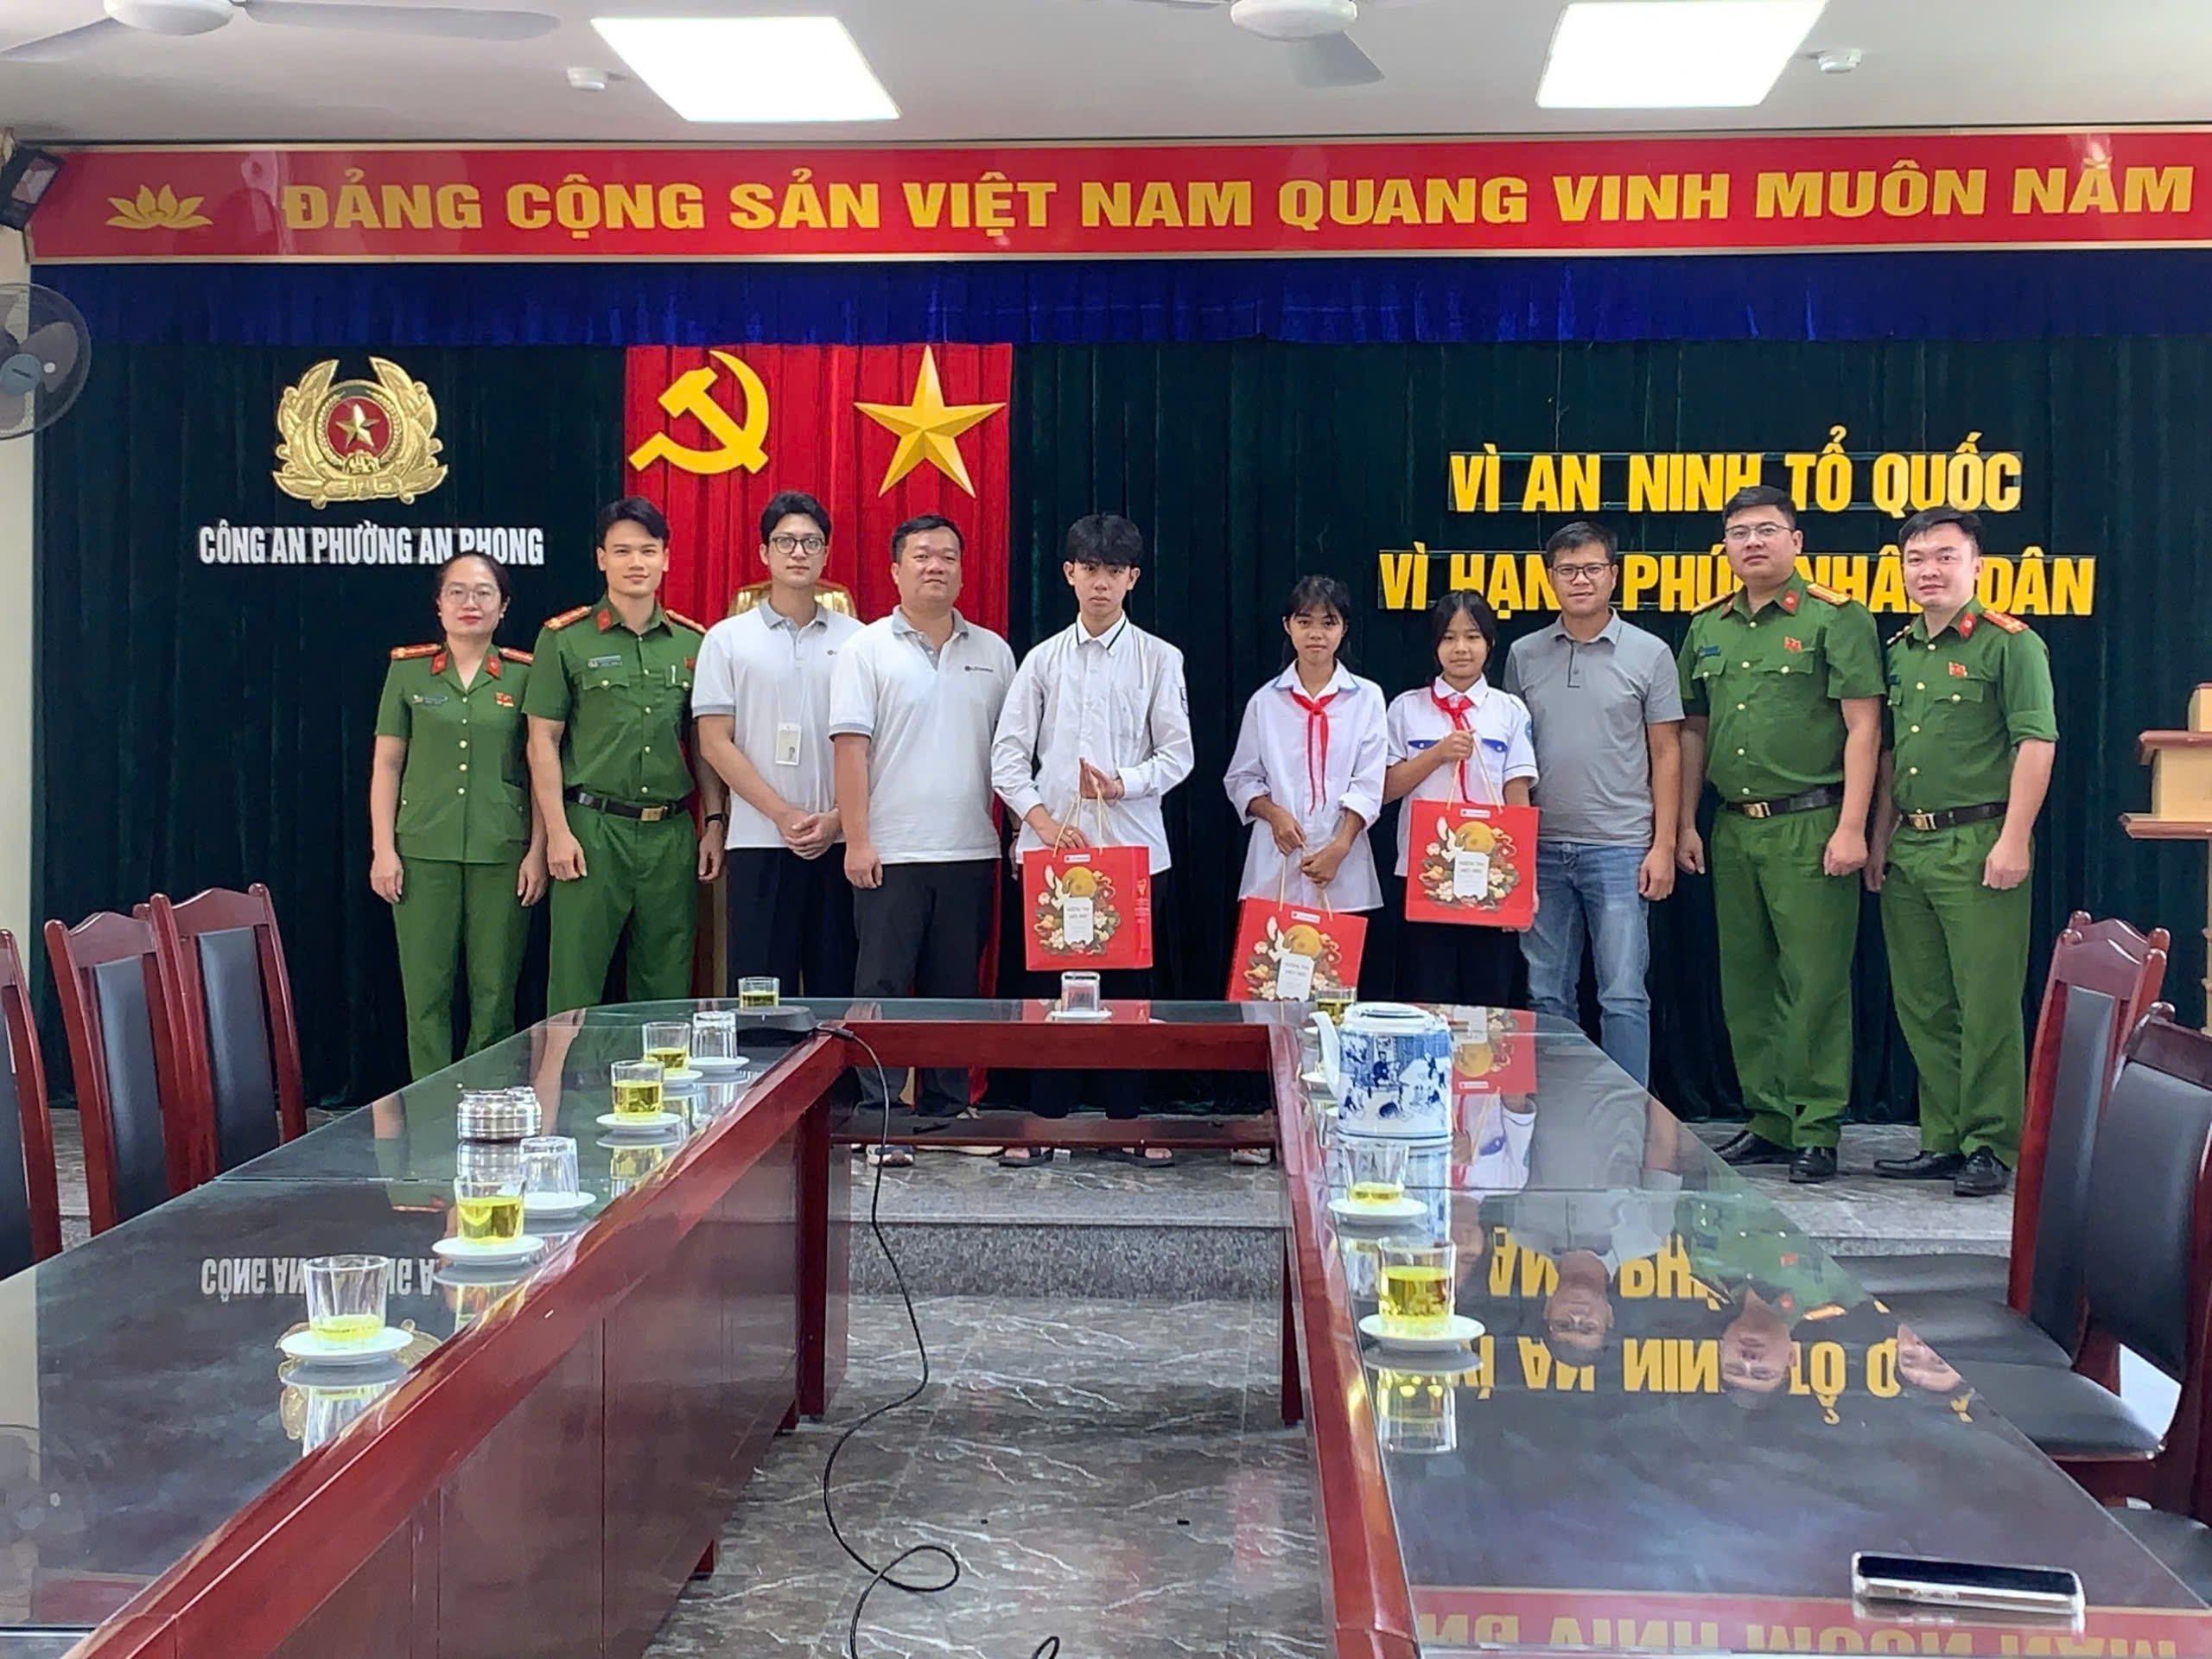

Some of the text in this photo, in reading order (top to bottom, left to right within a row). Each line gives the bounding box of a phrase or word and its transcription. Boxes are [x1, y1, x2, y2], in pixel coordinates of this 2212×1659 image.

[282, 156, 2195, 238] ĐẢNG CỘNG SẢN VIỆT NAM QUANG VINH MUÔN NĂM
[1449, 425, 2022, 517] VÌ AN NINH TỔ QUỐC
[199, 519, 544, 565] CÔNG AN PHƯỜNG AN PHONG
[1379, 541, 2095, 620] VÌ HẠN PHÚ HÂ DÂN
